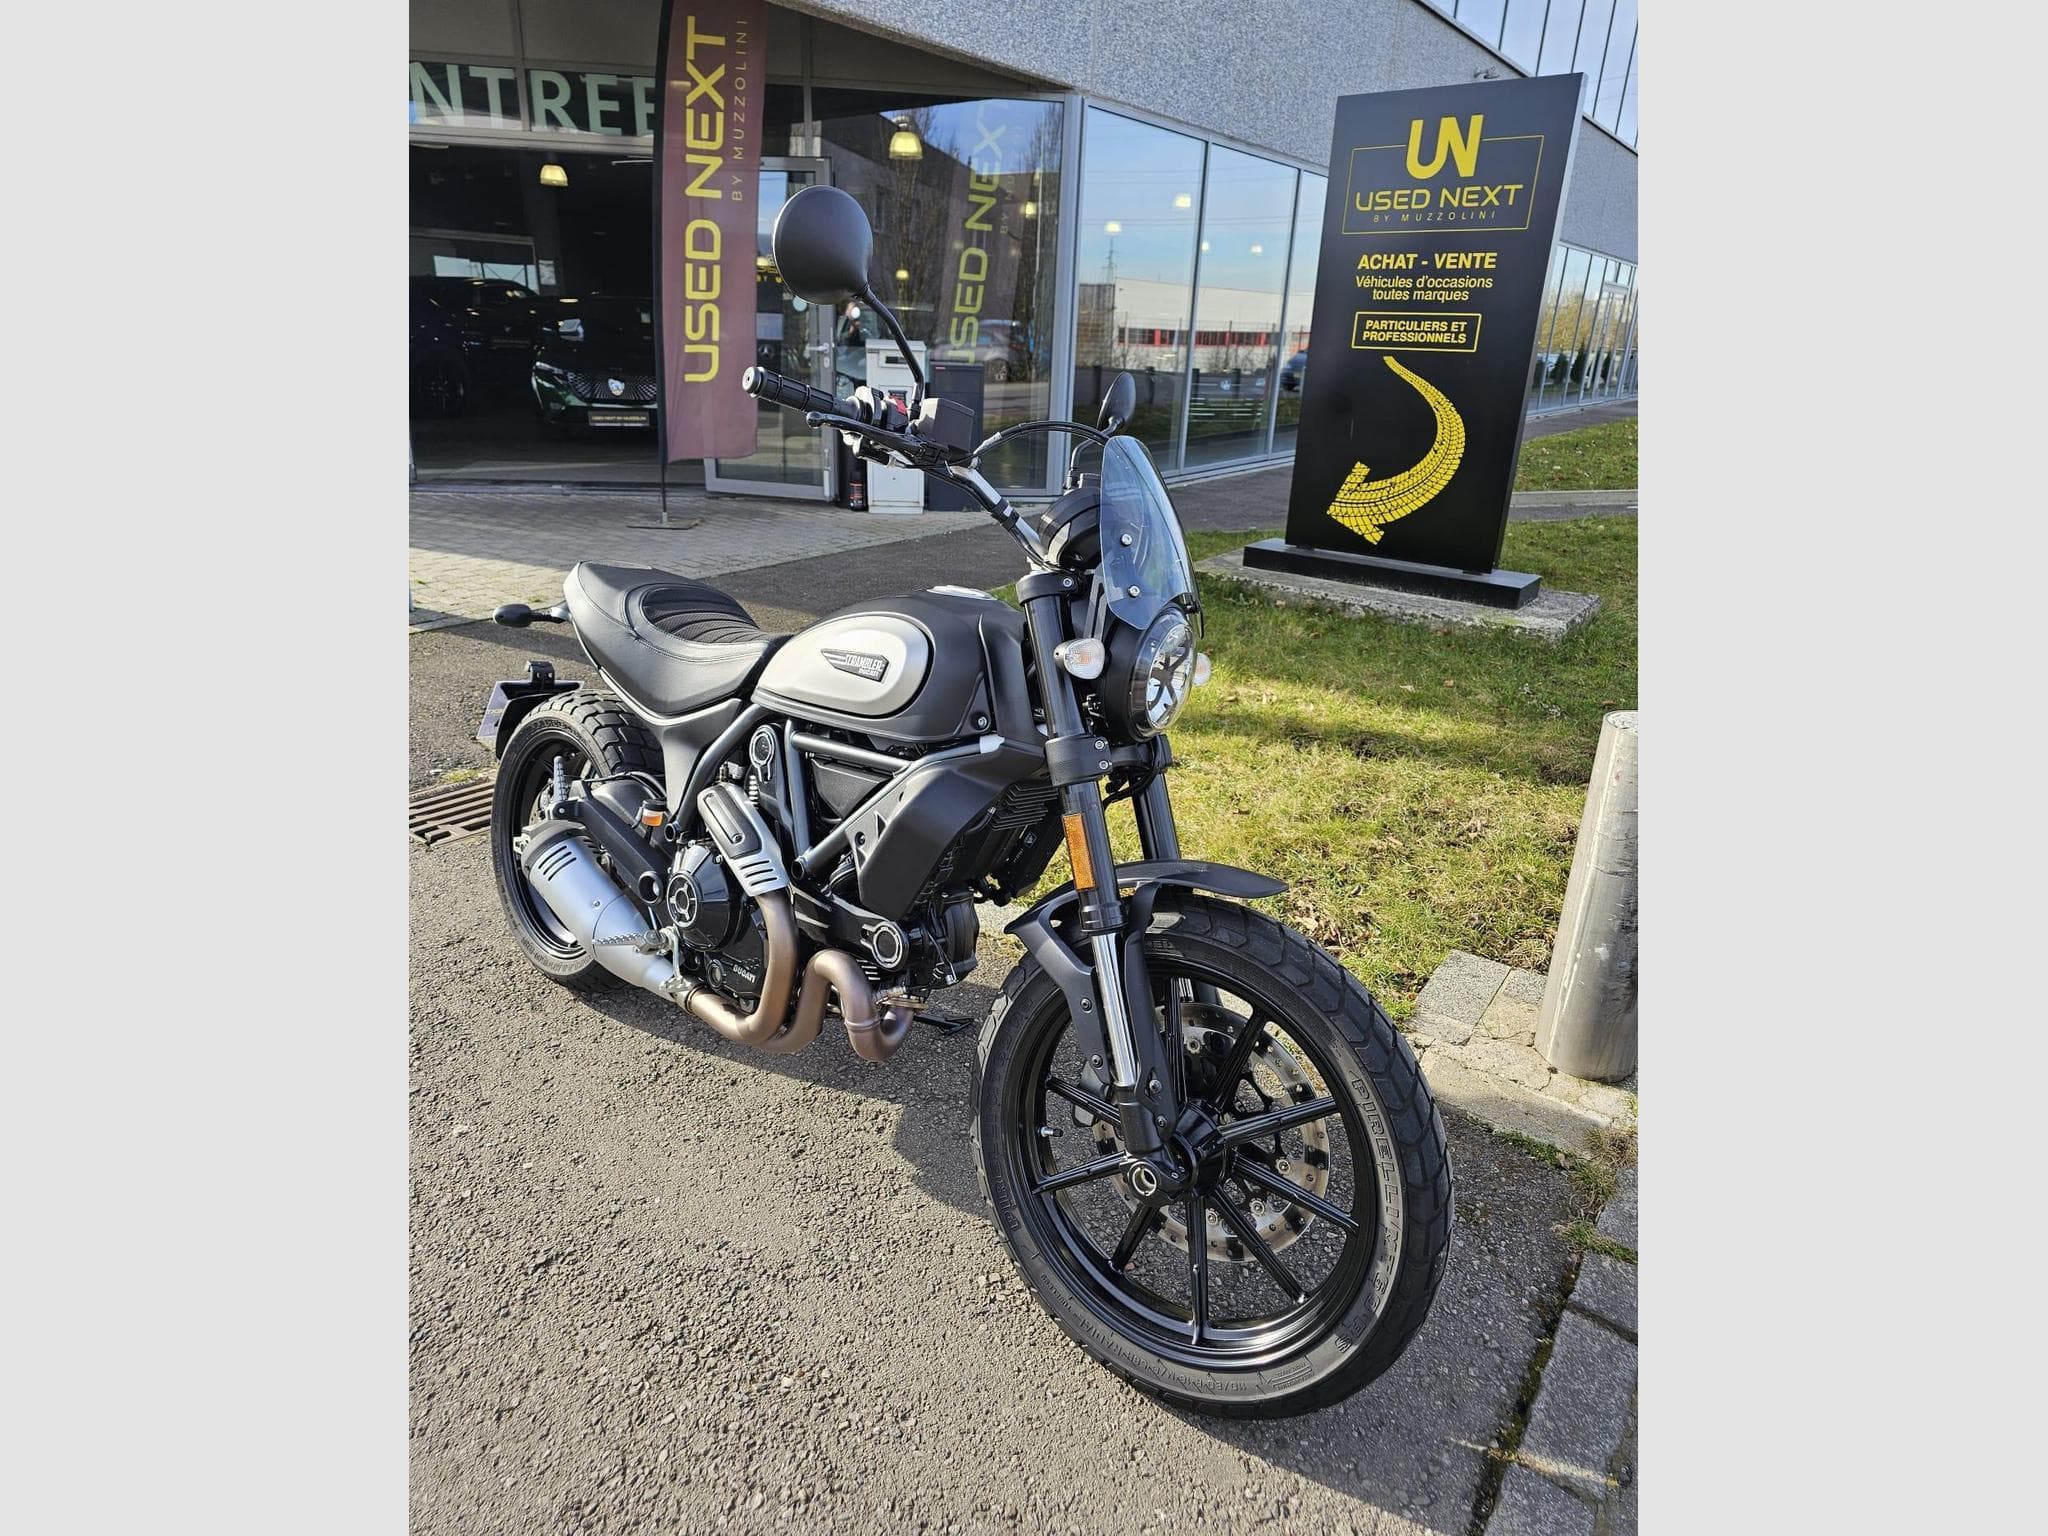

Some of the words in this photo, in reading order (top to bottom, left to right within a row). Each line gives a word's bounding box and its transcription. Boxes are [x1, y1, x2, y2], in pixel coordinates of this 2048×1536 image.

[732, 20, 749, 160] MUZZOLINI
[684, 15, 726, 199] NEXT
[1406, 114, 1484, 180] UN
[731, 175, 743, 201] BY
[1355, 188, 1431, 211] USED
[1439, 184, 1524, 209] NEXT
[1373, 214, 1390, 223] BY
[1401, 211, 1496, 222] MUZZOLINI
[1357, 253, 1418, 270] ACHAT
[1434, 252, 1498, 269] VENTE
[1355, 275, 1413, 288] Véhicules
[1416, 275, 1494, 288] d'occasions
[684, 218, 722, 382] USED
[1372, 289, 1410, 301] toutes
[1412, 290, 1470, 303] marques
[1362, 331, 1467, 344] PROFESSIONNELS
[1365, 319, 1449, 332] PARTICULIERS
[1450, 321, 1468, 332] ET
[1351, 1079, 1399, 1225] PIRELLI
